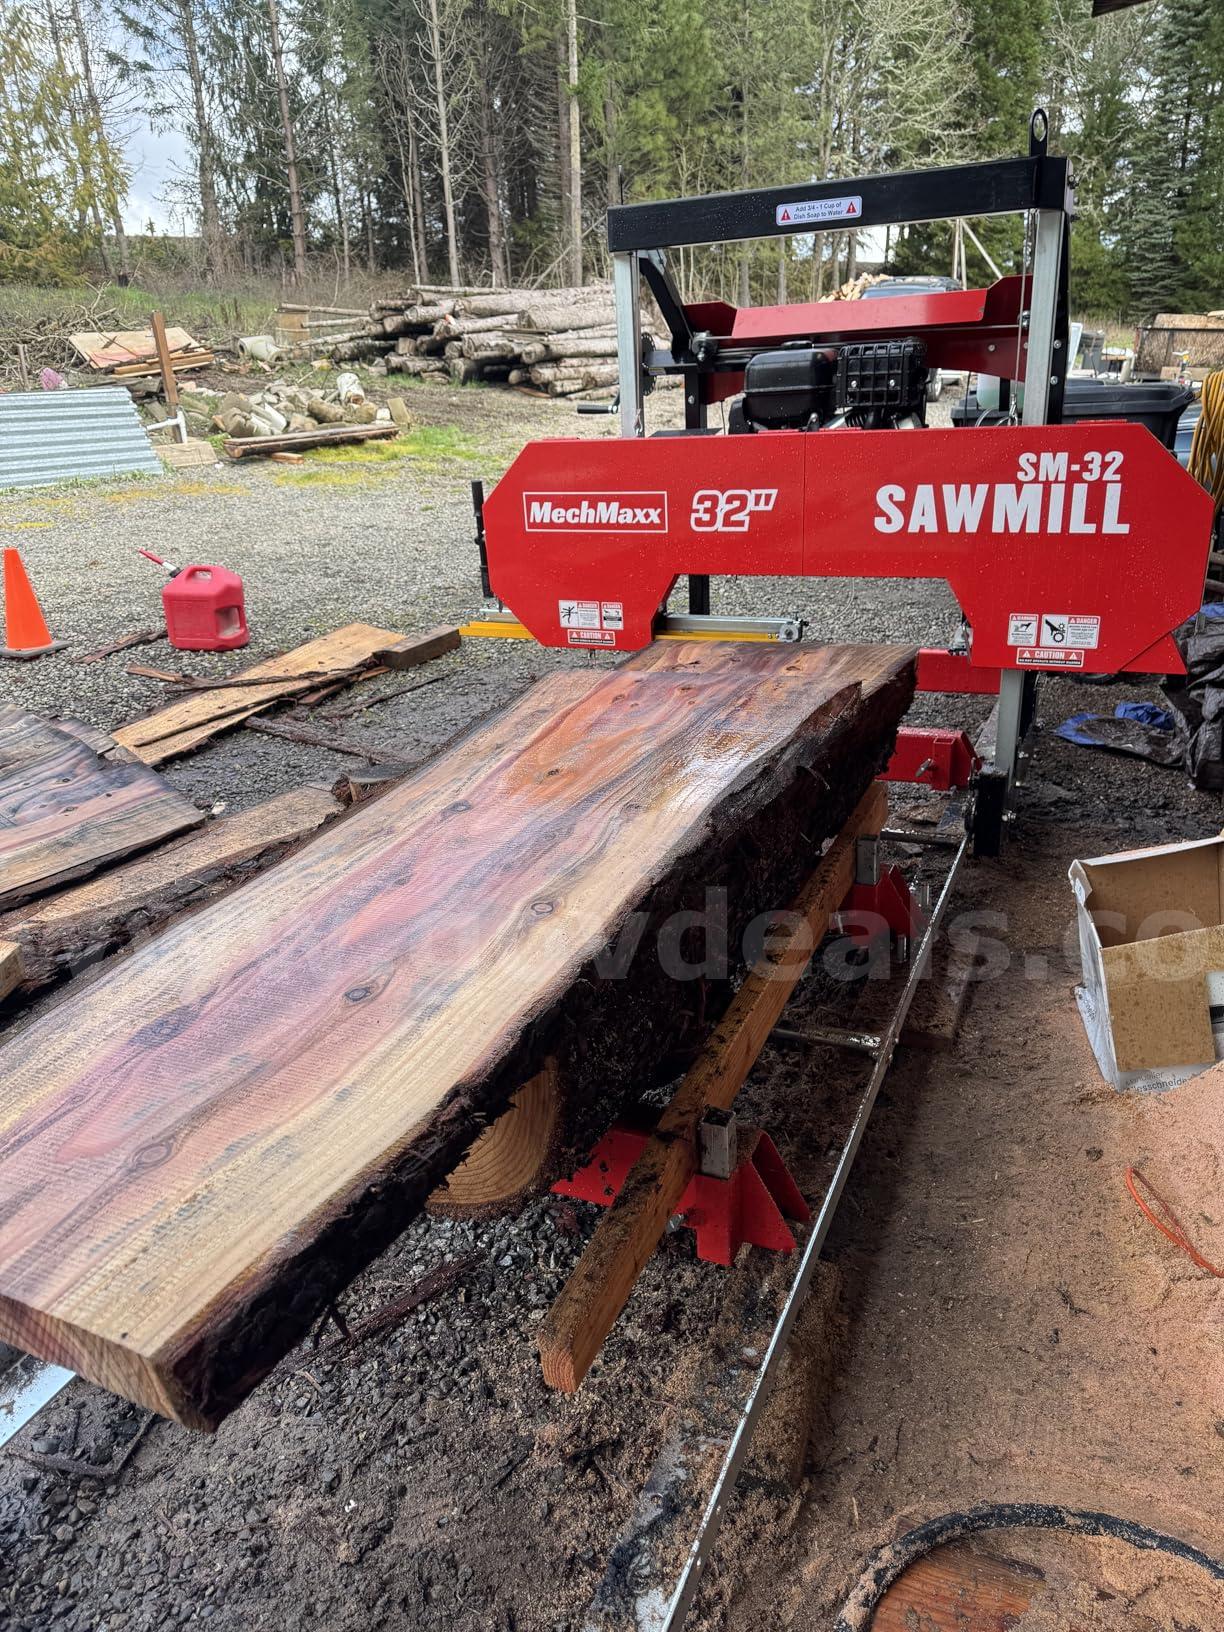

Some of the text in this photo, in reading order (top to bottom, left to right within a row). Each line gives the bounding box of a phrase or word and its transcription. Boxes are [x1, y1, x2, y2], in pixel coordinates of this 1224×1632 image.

[1016, 450, 1125, 482] SM-32
[529, 500, 662, 525] MechMaxx
[873, 483, 1131, 534] SAWMILL
[1034, 651, 1065, 659] CAUTION
